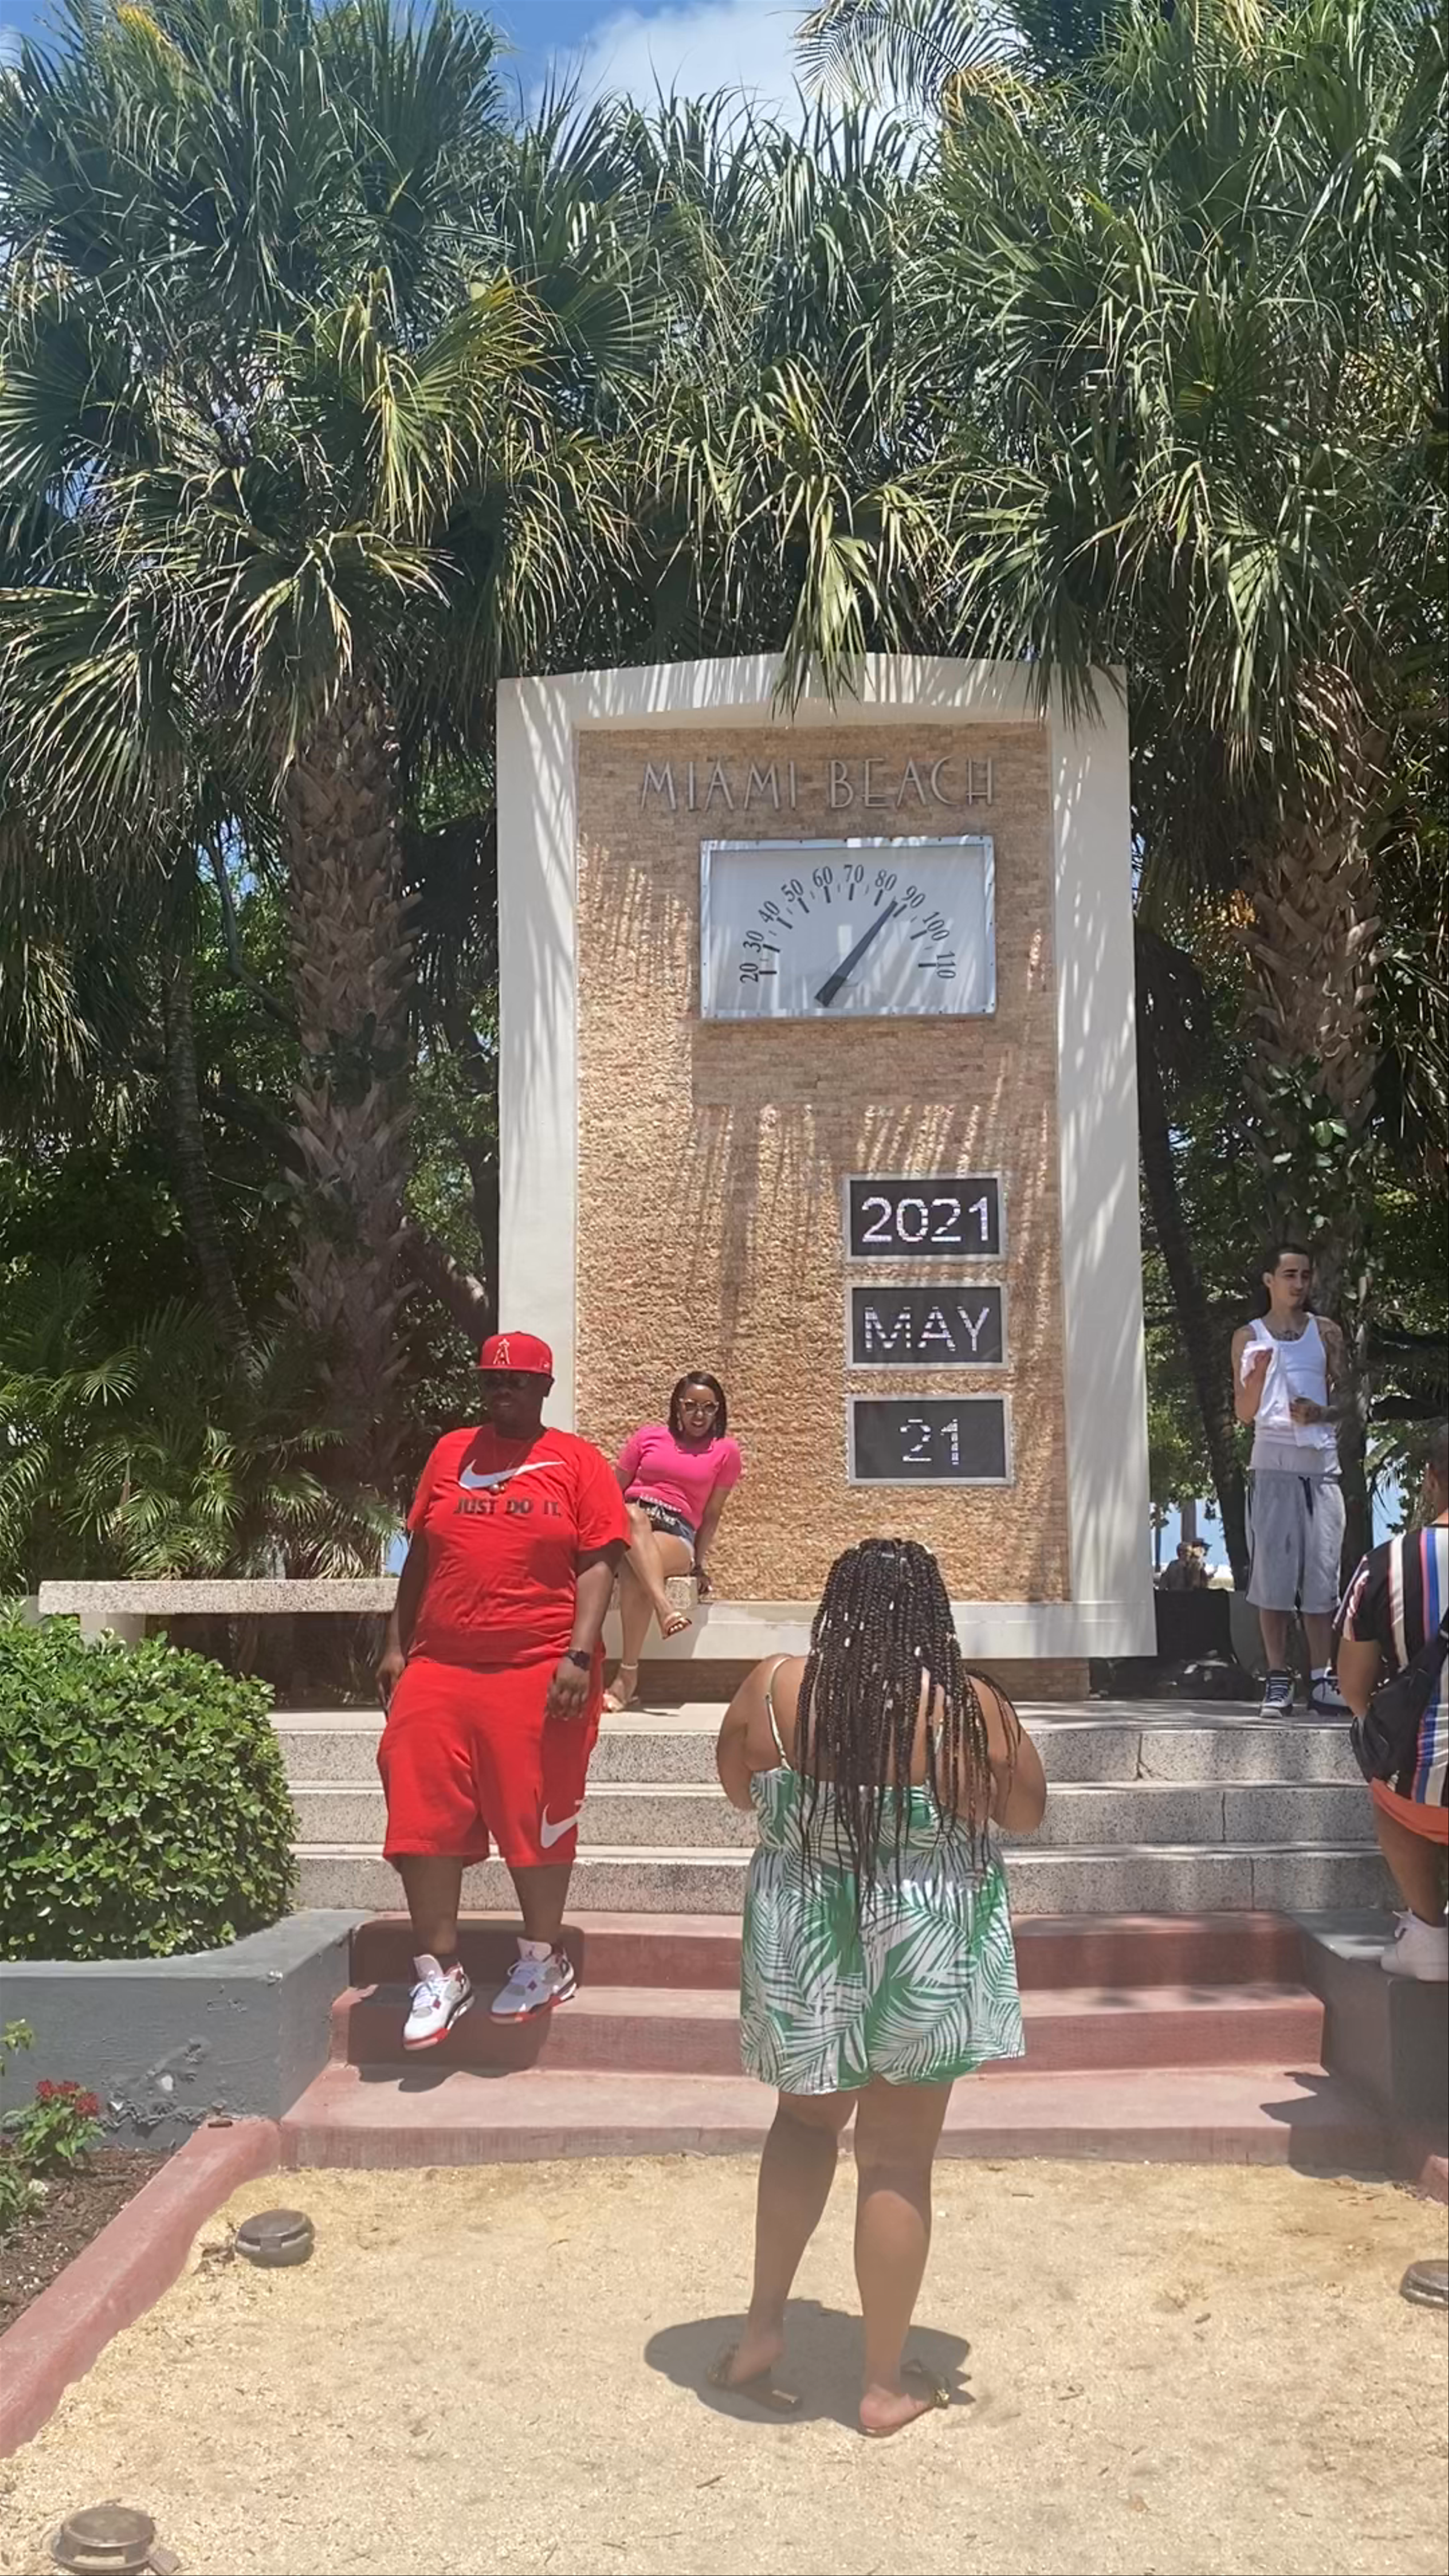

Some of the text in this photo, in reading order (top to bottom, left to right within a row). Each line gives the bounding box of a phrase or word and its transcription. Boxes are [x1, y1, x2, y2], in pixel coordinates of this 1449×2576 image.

[640, 756, 993, 810] MIAMI BEACH
[739, 864, 956, 983] 20 30 40 50 60 70 80 90 100 110
[861, 1197, 988, 1243] 2021
[865, 1306, 990, 1351] MAY
[900, 1419, 959, 1465] 21
[455, 1498, 498, 1515] JUST
[506, 1499, 532, 1514] DO
